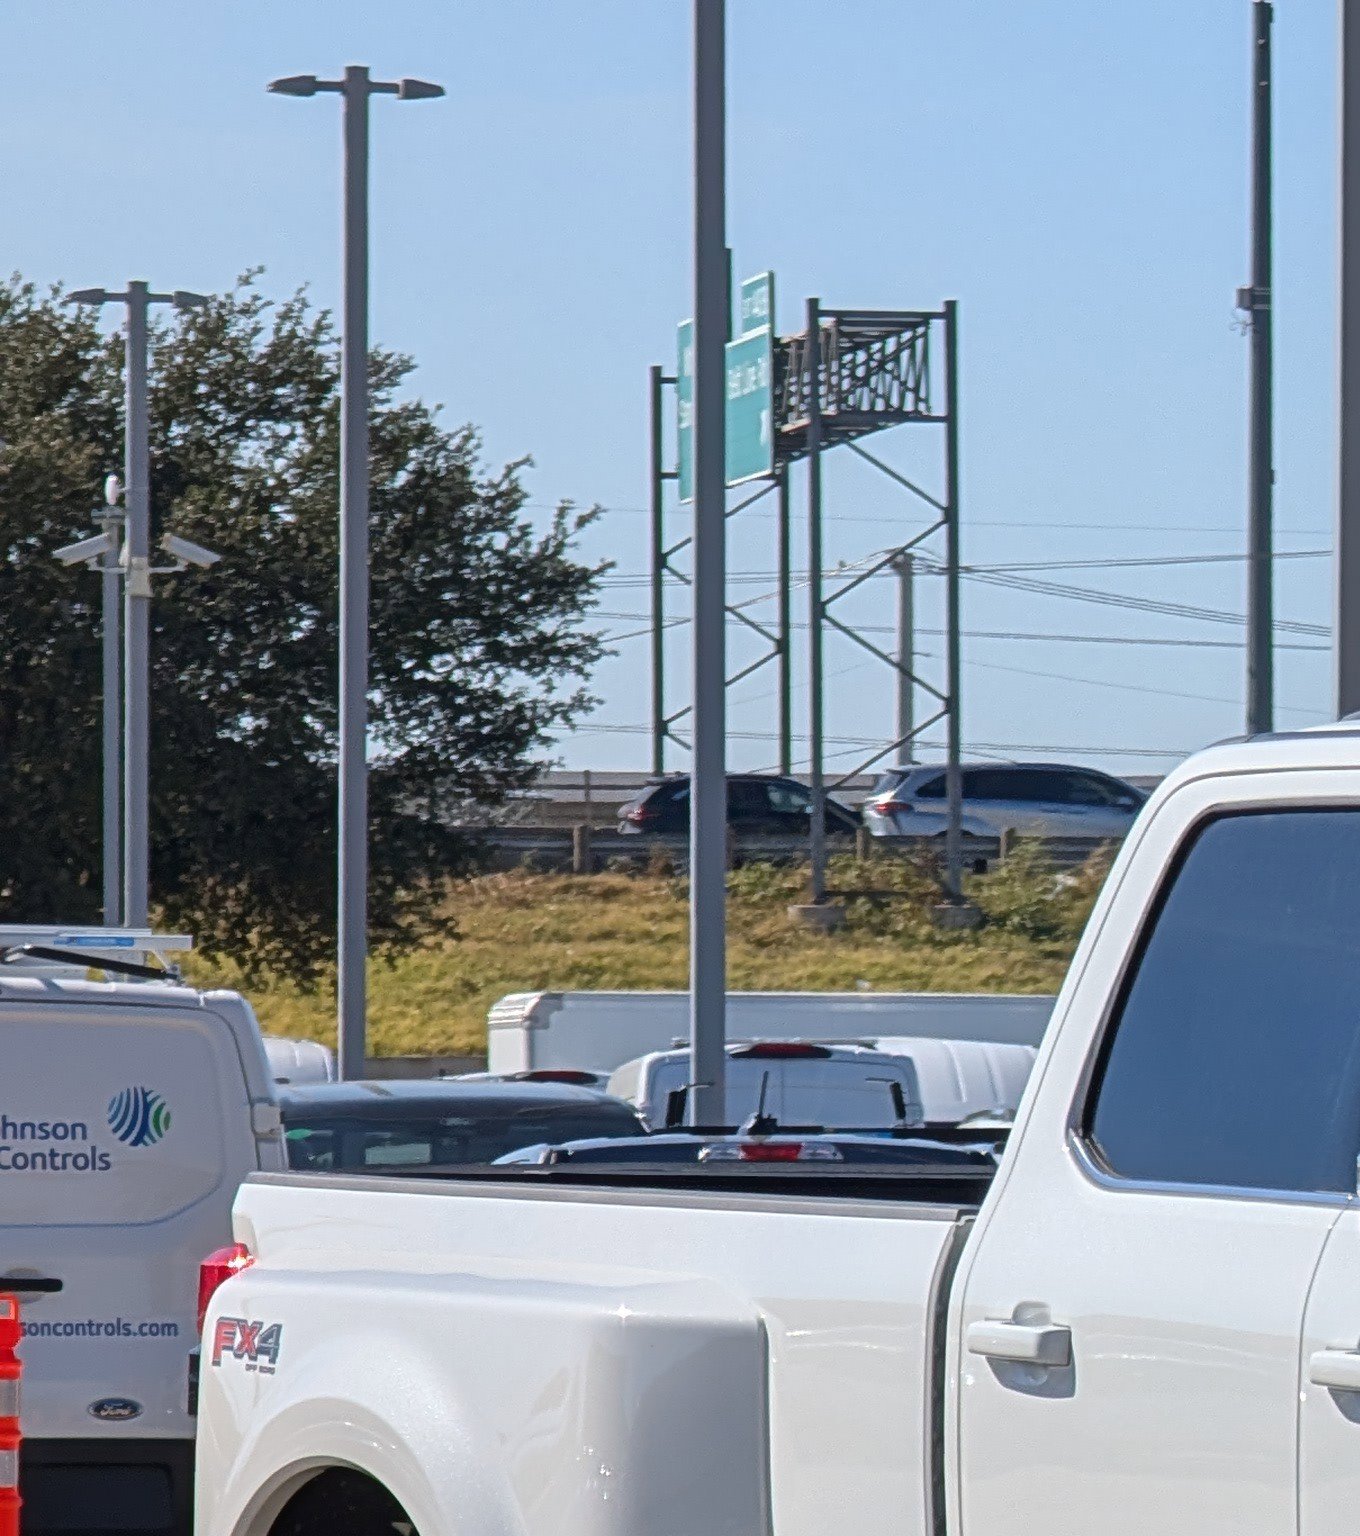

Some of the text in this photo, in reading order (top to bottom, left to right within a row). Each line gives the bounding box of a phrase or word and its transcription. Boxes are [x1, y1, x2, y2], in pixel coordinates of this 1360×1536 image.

[1, 1114, 88, 1141] hnson
[0, 1145, 112, 1172] Controls
[211, 1316, 283, 1367] FX4
